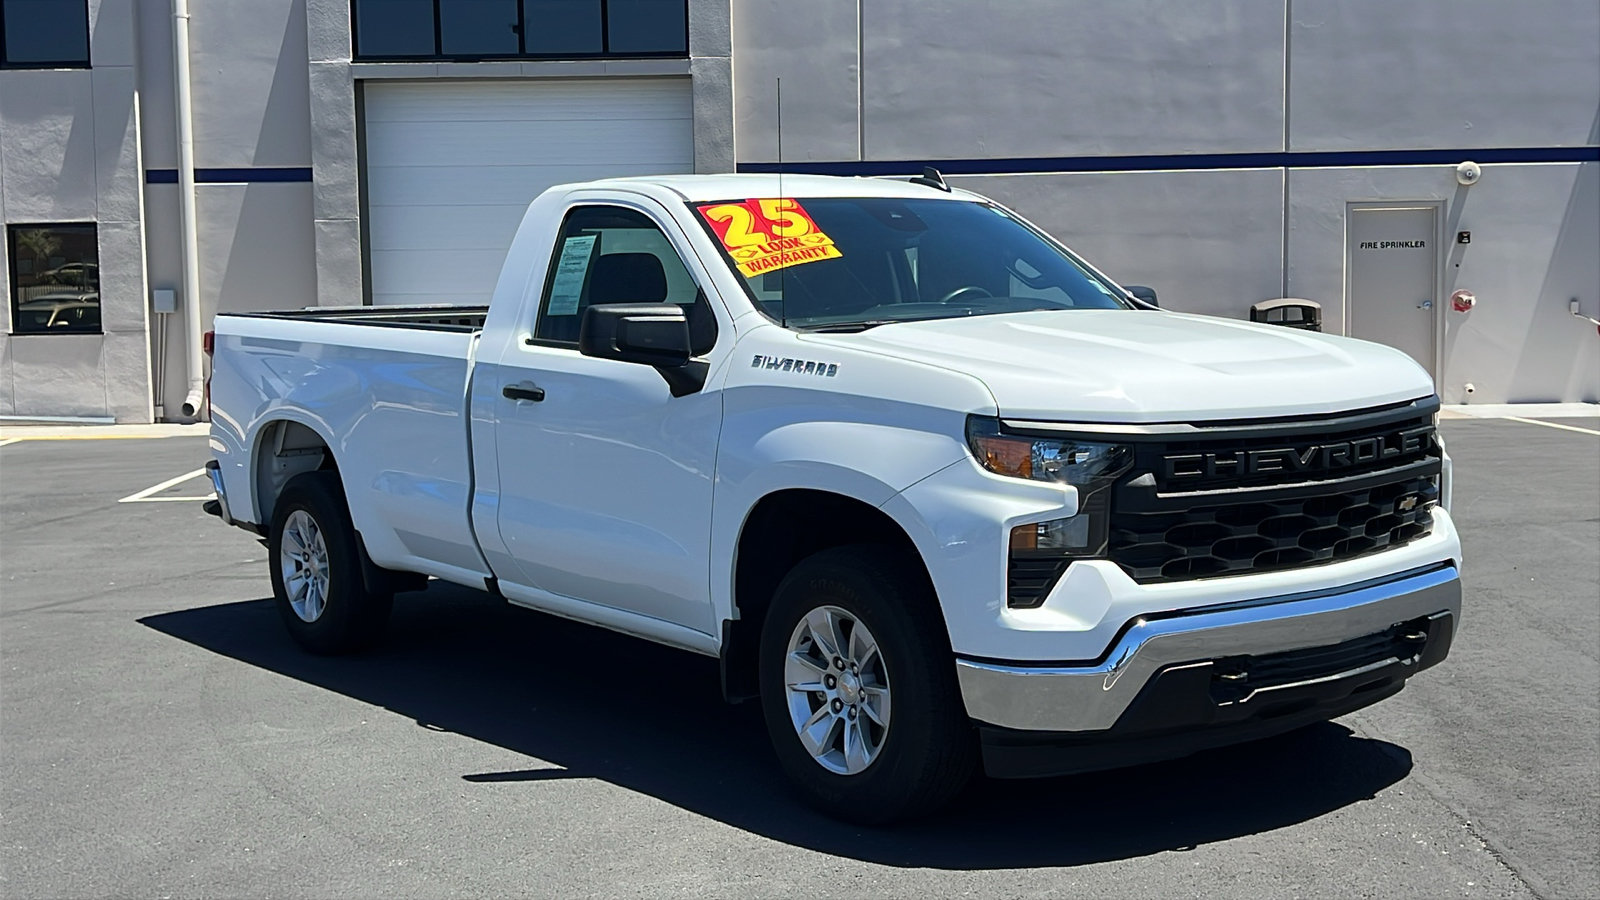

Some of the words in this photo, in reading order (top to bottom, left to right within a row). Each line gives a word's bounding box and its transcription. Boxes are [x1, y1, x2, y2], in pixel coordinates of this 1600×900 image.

[706, 199, 814, 248] 25
[757, 237, 805, 255] LOOK
[1360, 241, 1378, 249] FIRE
[1380, 240, 1425, 249] SPRINKLER
[745, 246, 828, 273] WARRANTY
[751, 354, 838, 377] SILVERADO
